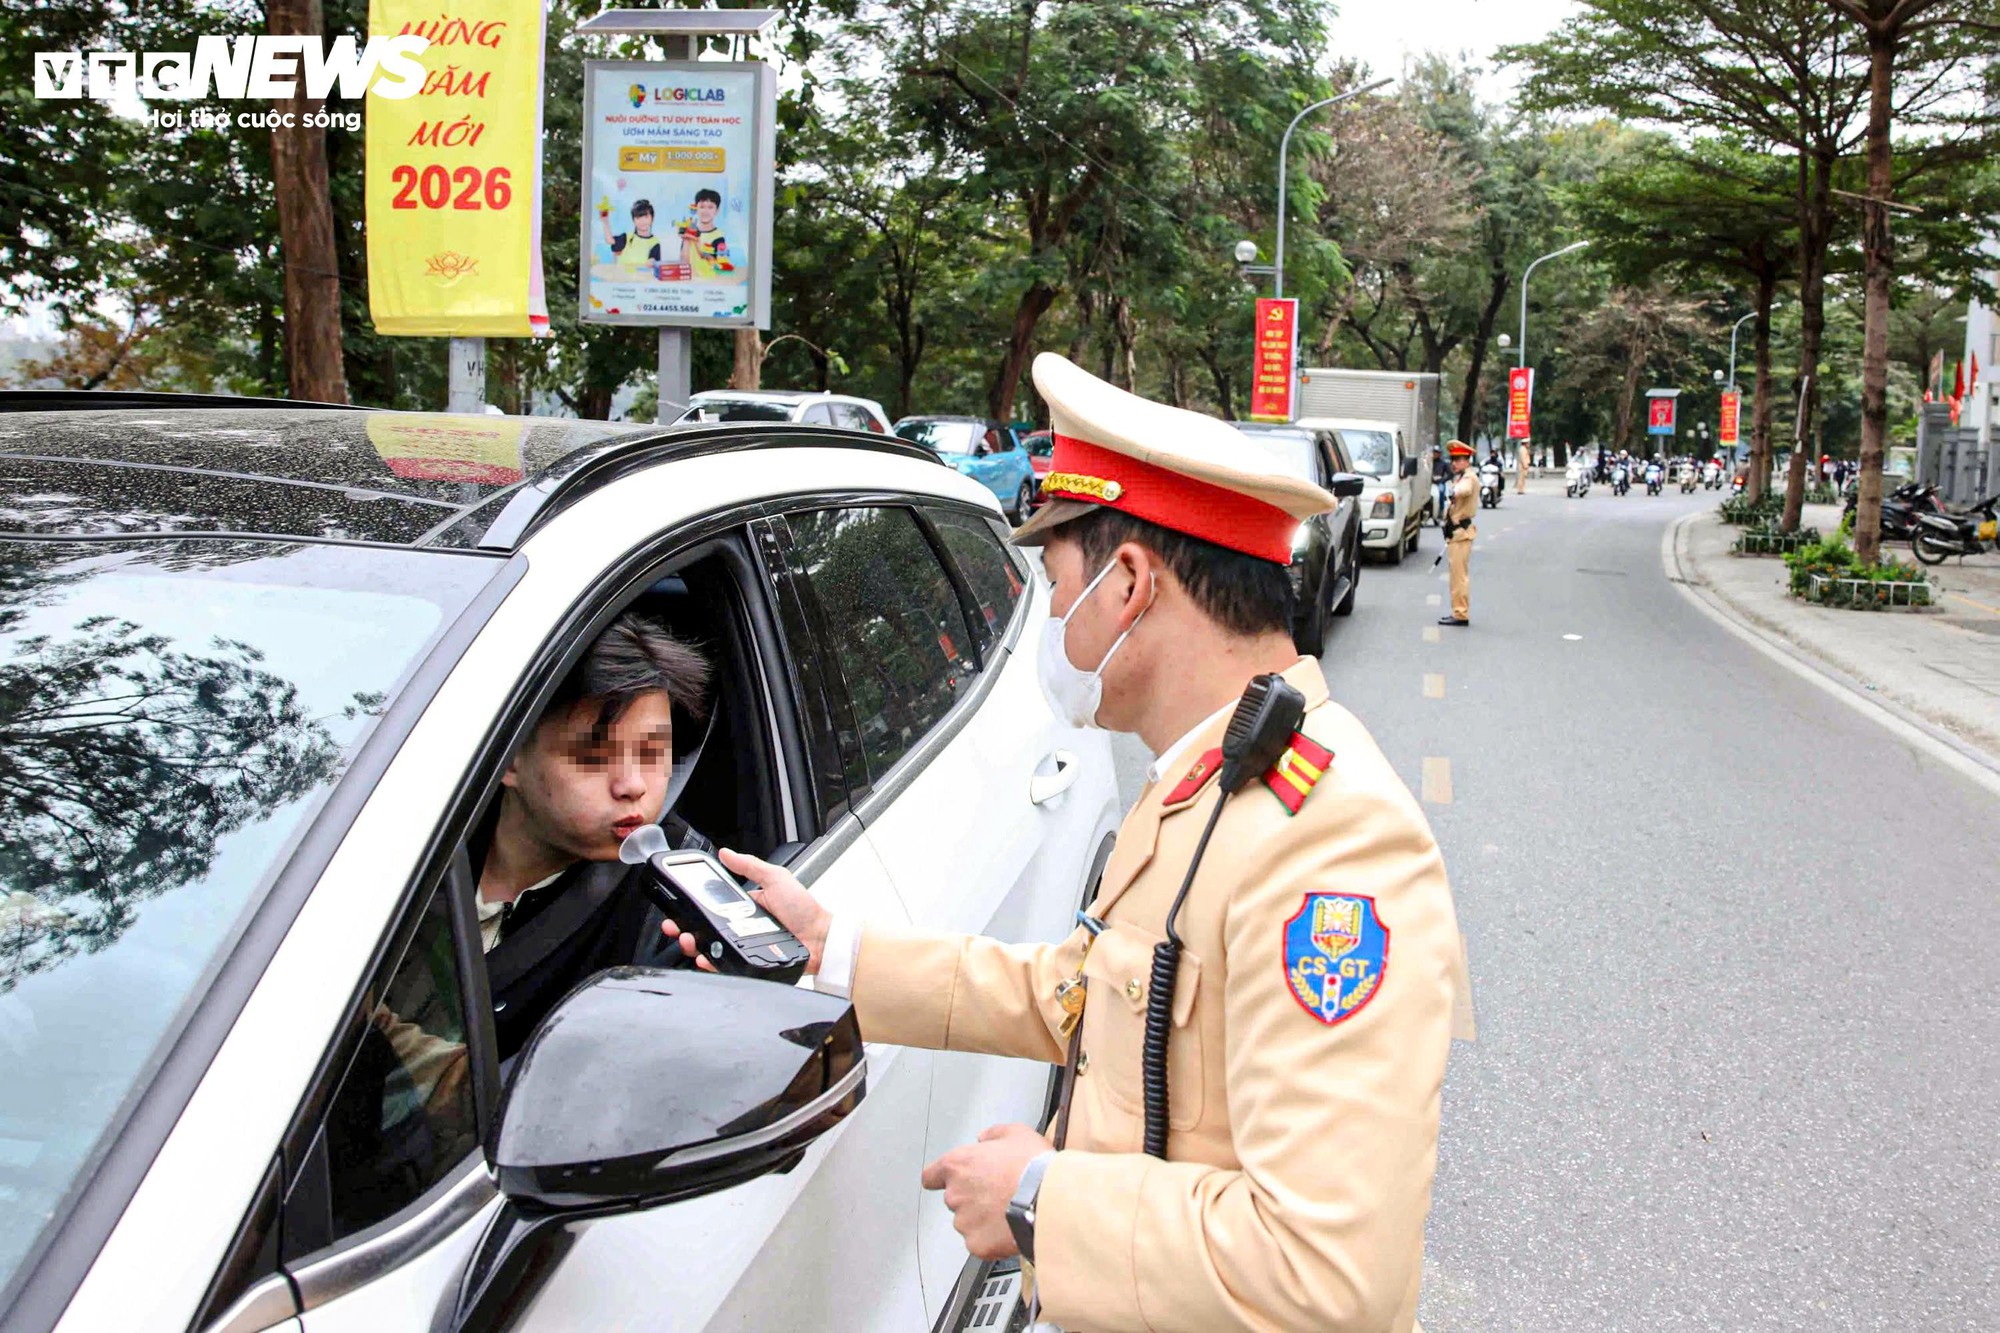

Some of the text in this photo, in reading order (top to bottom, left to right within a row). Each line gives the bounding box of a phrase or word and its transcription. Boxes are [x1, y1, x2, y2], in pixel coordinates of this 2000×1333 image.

[418, 64, 491, 99] ĂM
[655, 88, 725, 102] LOGICLAB
[407, 114, 485, 148] MỚI
[392, 164, 512, 210] 2026
[1298, 956, 1370, 978] CS GT
